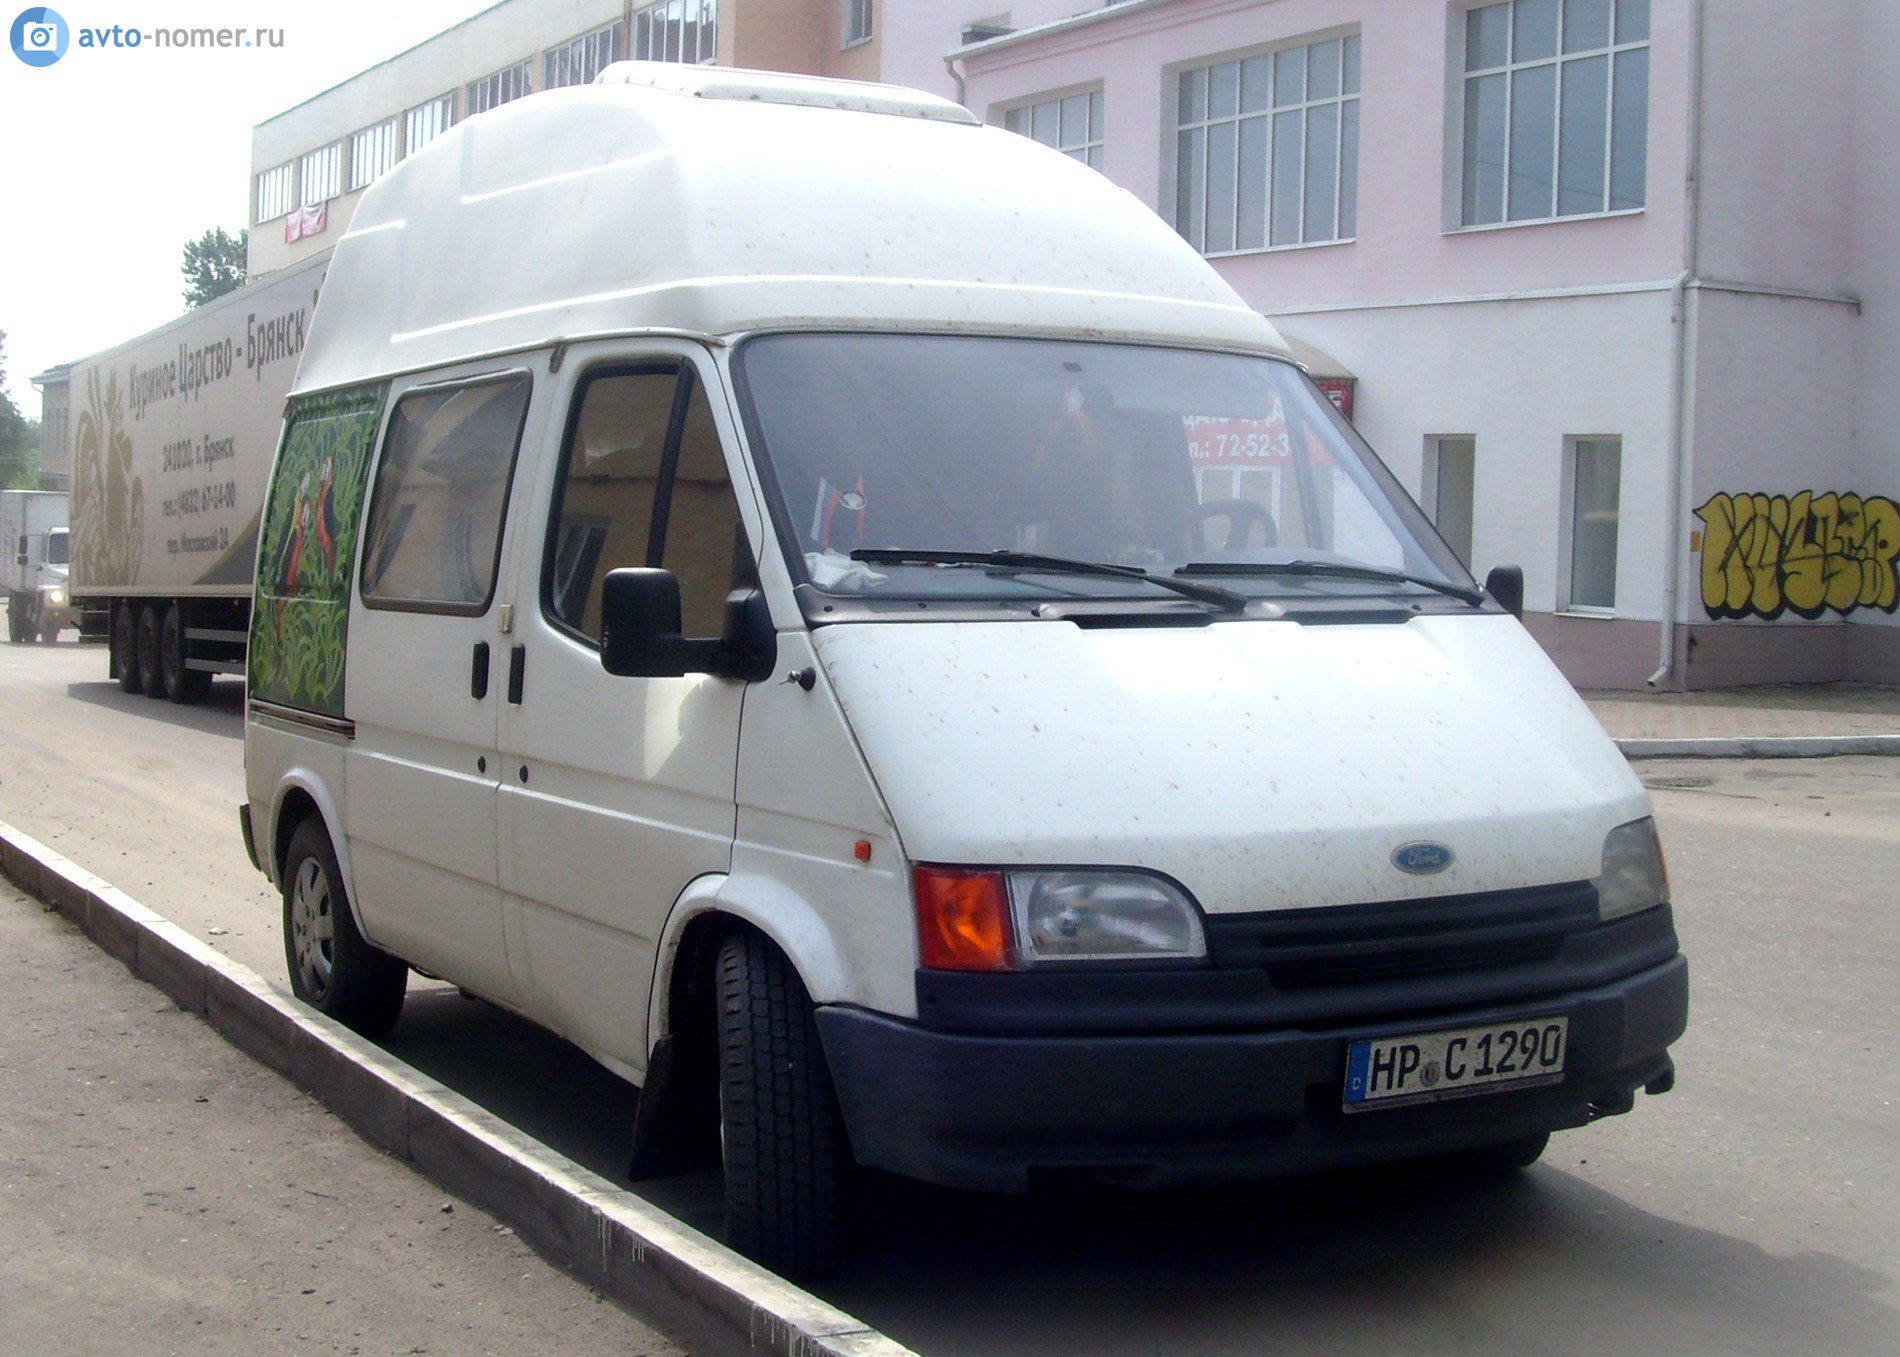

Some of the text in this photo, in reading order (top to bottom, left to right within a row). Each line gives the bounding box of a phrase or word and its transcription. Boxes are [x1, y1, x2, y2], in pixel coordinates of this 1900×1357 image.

[129, 360, 176, 421] Куриное
[179, 336, 233, 403] Царство
[246, 306, 306, 381] Брянск
[1216, 432, 1290, 458] 72-52-3
[1370, 1044, 1421, 1092] HP
